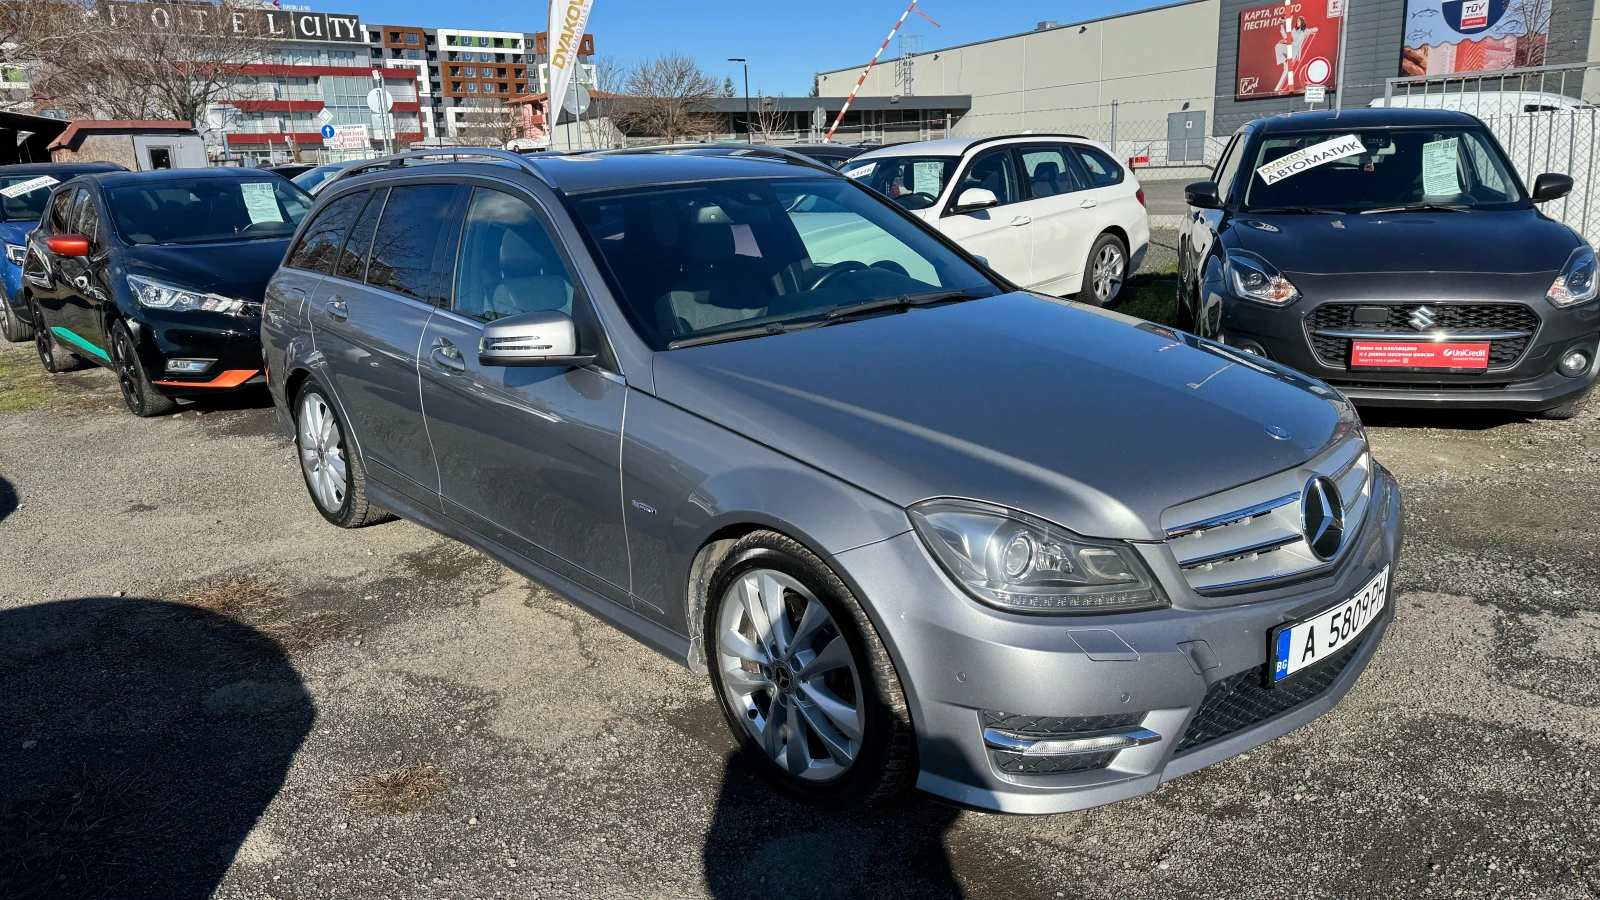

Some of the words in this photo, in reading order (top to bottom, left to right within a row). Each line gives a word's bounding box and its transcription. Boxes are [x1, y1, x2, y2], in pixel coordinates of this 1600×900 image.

[1244, 9, 1272, 21] КАРТА,
[1274, 4, 1302, 17] КОТО
[300, 15, 358, 38] CITY
[567, 4, 589, 67] AUTOMOBILES
[1244, 18, 1269, 31] ПЕСТИ
[1242, 77, 1259, 93] Card
[1261, 150, 1307, 175] DYAKOV
[1268, 141, 1361, 183] АВТОМАТИК
[1302, 625, 1315, 663] A
[1276, 659, 1288, 672] BG
